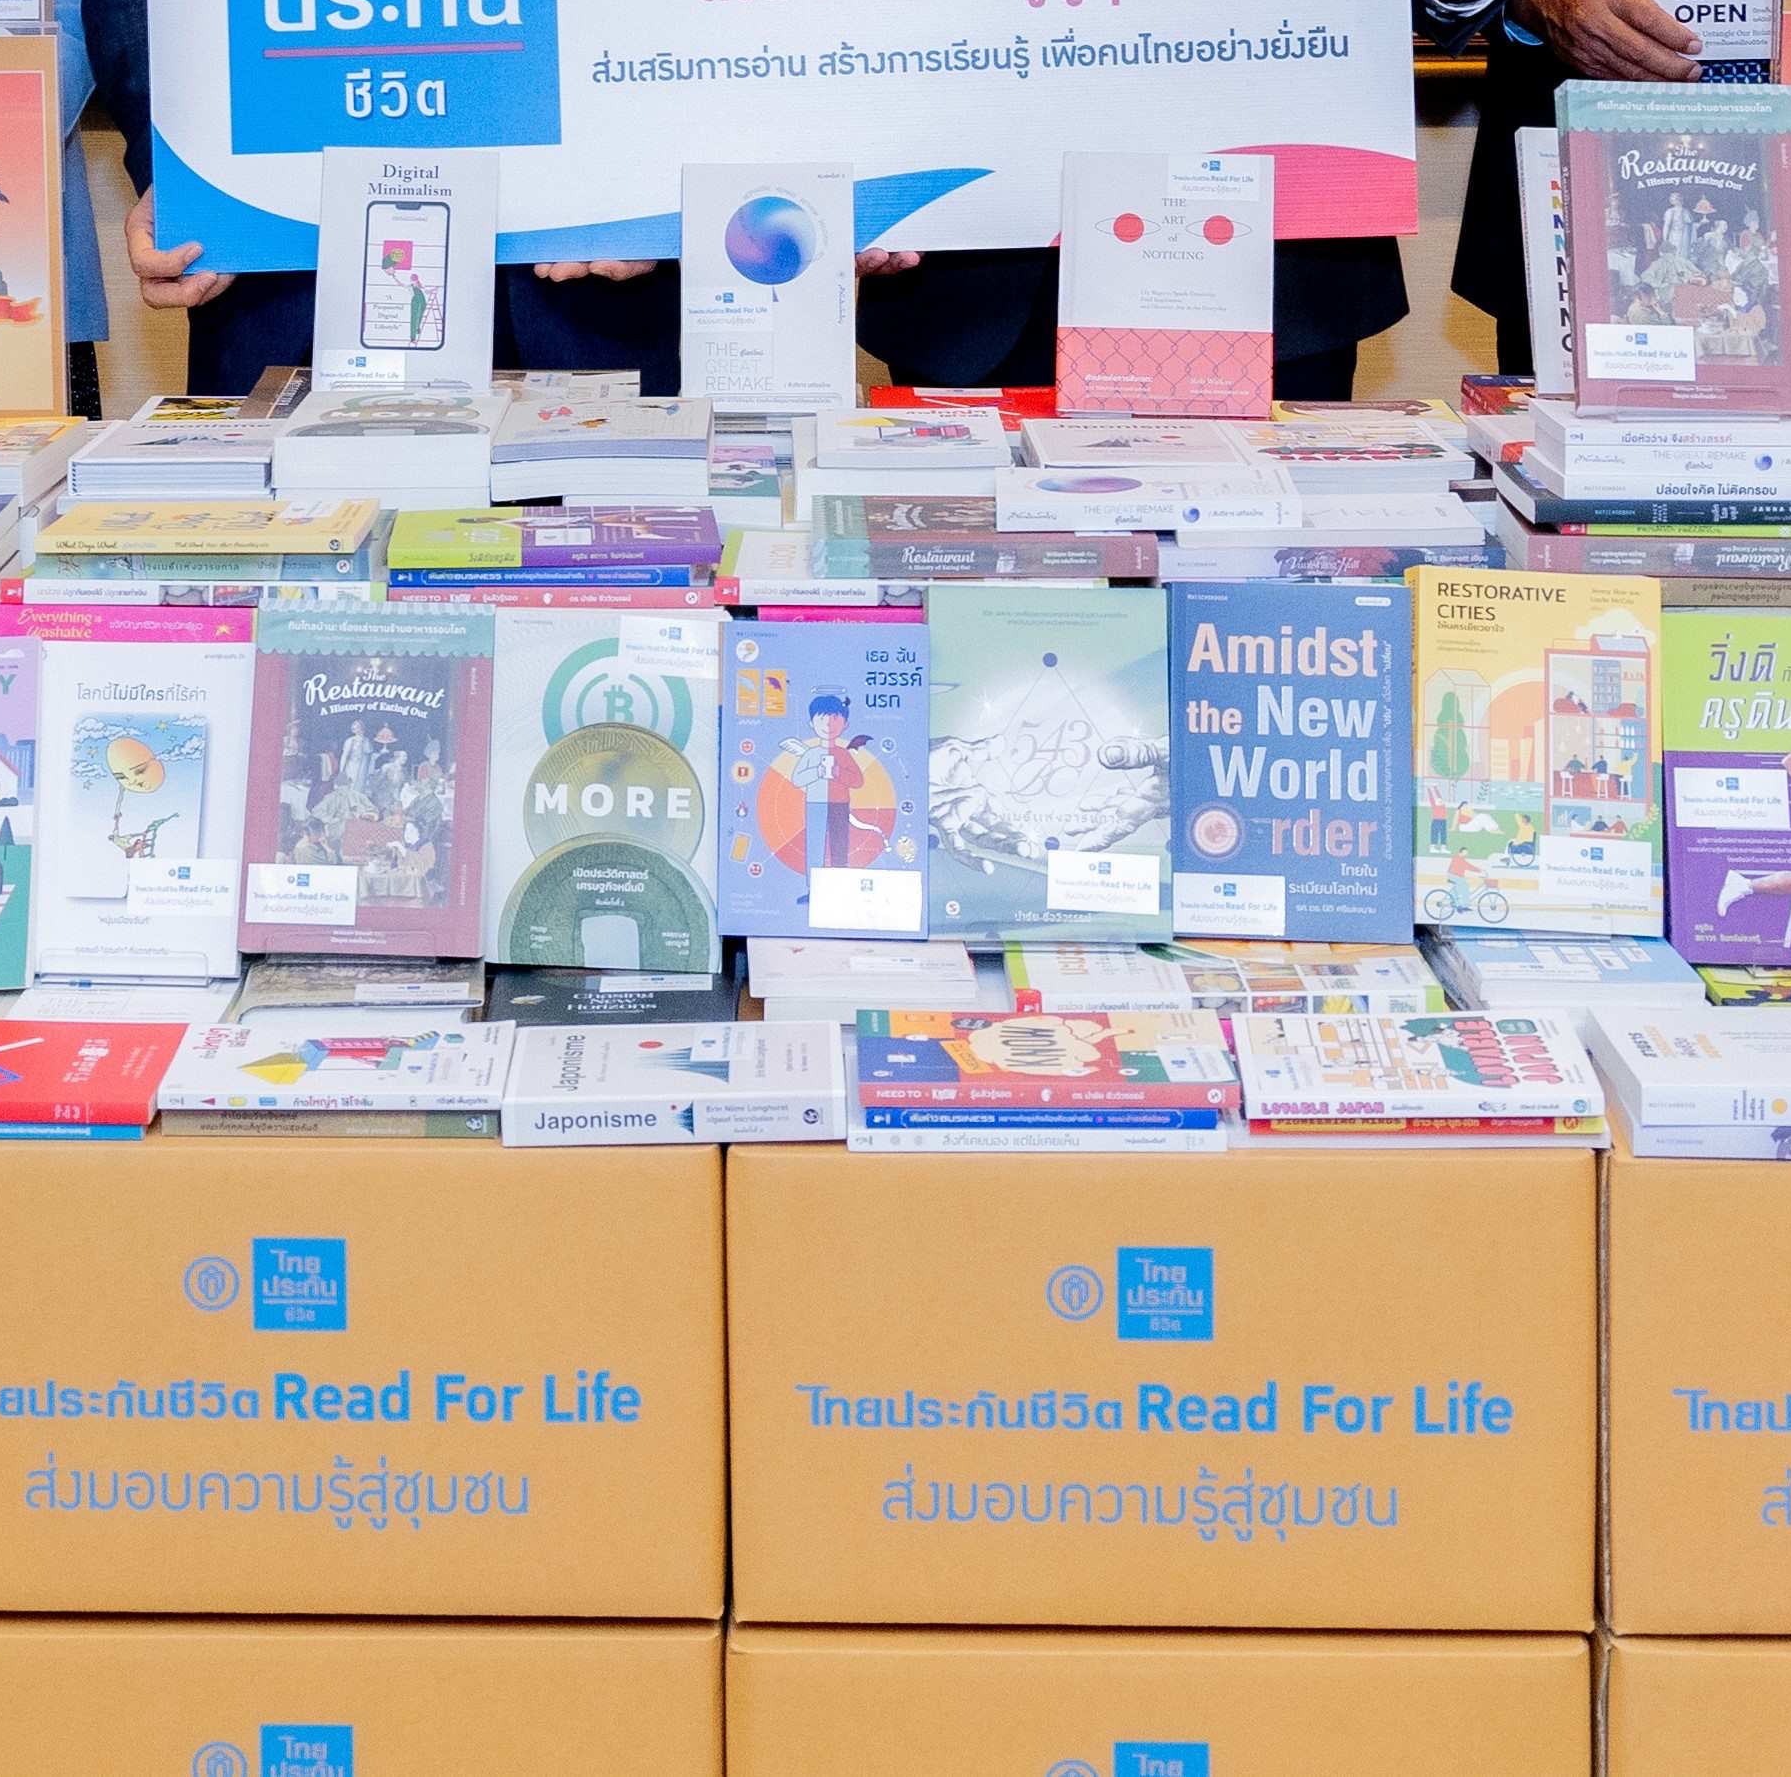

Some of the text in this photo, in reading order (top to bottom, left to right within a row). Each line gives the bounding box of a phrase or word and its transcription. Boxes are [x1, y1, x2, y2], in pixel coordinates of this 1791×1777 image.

[1674, 4, 1747, 23] OPEN
[592, 20, 1349, 83] ส่งเสริมการอ่าน สร้างการเรียนรู้ เพื่อคนไทยอย่างยั่งยืน
[345, 68, 446, 118] ชีวิต
[383, 164, 439, 182] Digital
[1618, 149, 1758, 181] Restaurant
[367, 182, 452, 197] Minimalism
[1162, 197, 1187, 207] THE
[1162, 215, 1186, 225] ART
[1168, 233, 1178, 242] of
[1142, 250, 1204, 261] NOTICING
[705, 342, 738, 357] THE
[901, 545, 976, 567] Restaurant
[1437, 581, 1567, 604] RESTORATIVE
[1436, 603, 1497, 622] CITIES
[866, 645, 916, 664] เธอ ฉัน
[1187, 622, 1379, 678] Amidst
[362, 668, 387, 681] The
[865, 666, 923, 687] สวรรค์
[303, 673, 445, 708] Restaurant
[320, 700, 428, 719] A History of Eating Out
[866, 694, 900, 709] นรก
[1186, 684, 1377, 738] the New
[1209, 744, 1379, 802] World
[534, 781, 692, 819] MORE
[553, 1033, 586, 1093] Japonisme
[1261, 1101, 1386, 1115] LOVABLE JAPAN
[534, 1109, 657, 1132] Japonisme
[797, 1381, 1515, 1436] ไทยประกันชีวิต Read For Life
[883, 1465, 1398, 1543] ส่งมอบความรู้สู่ชุมชน
